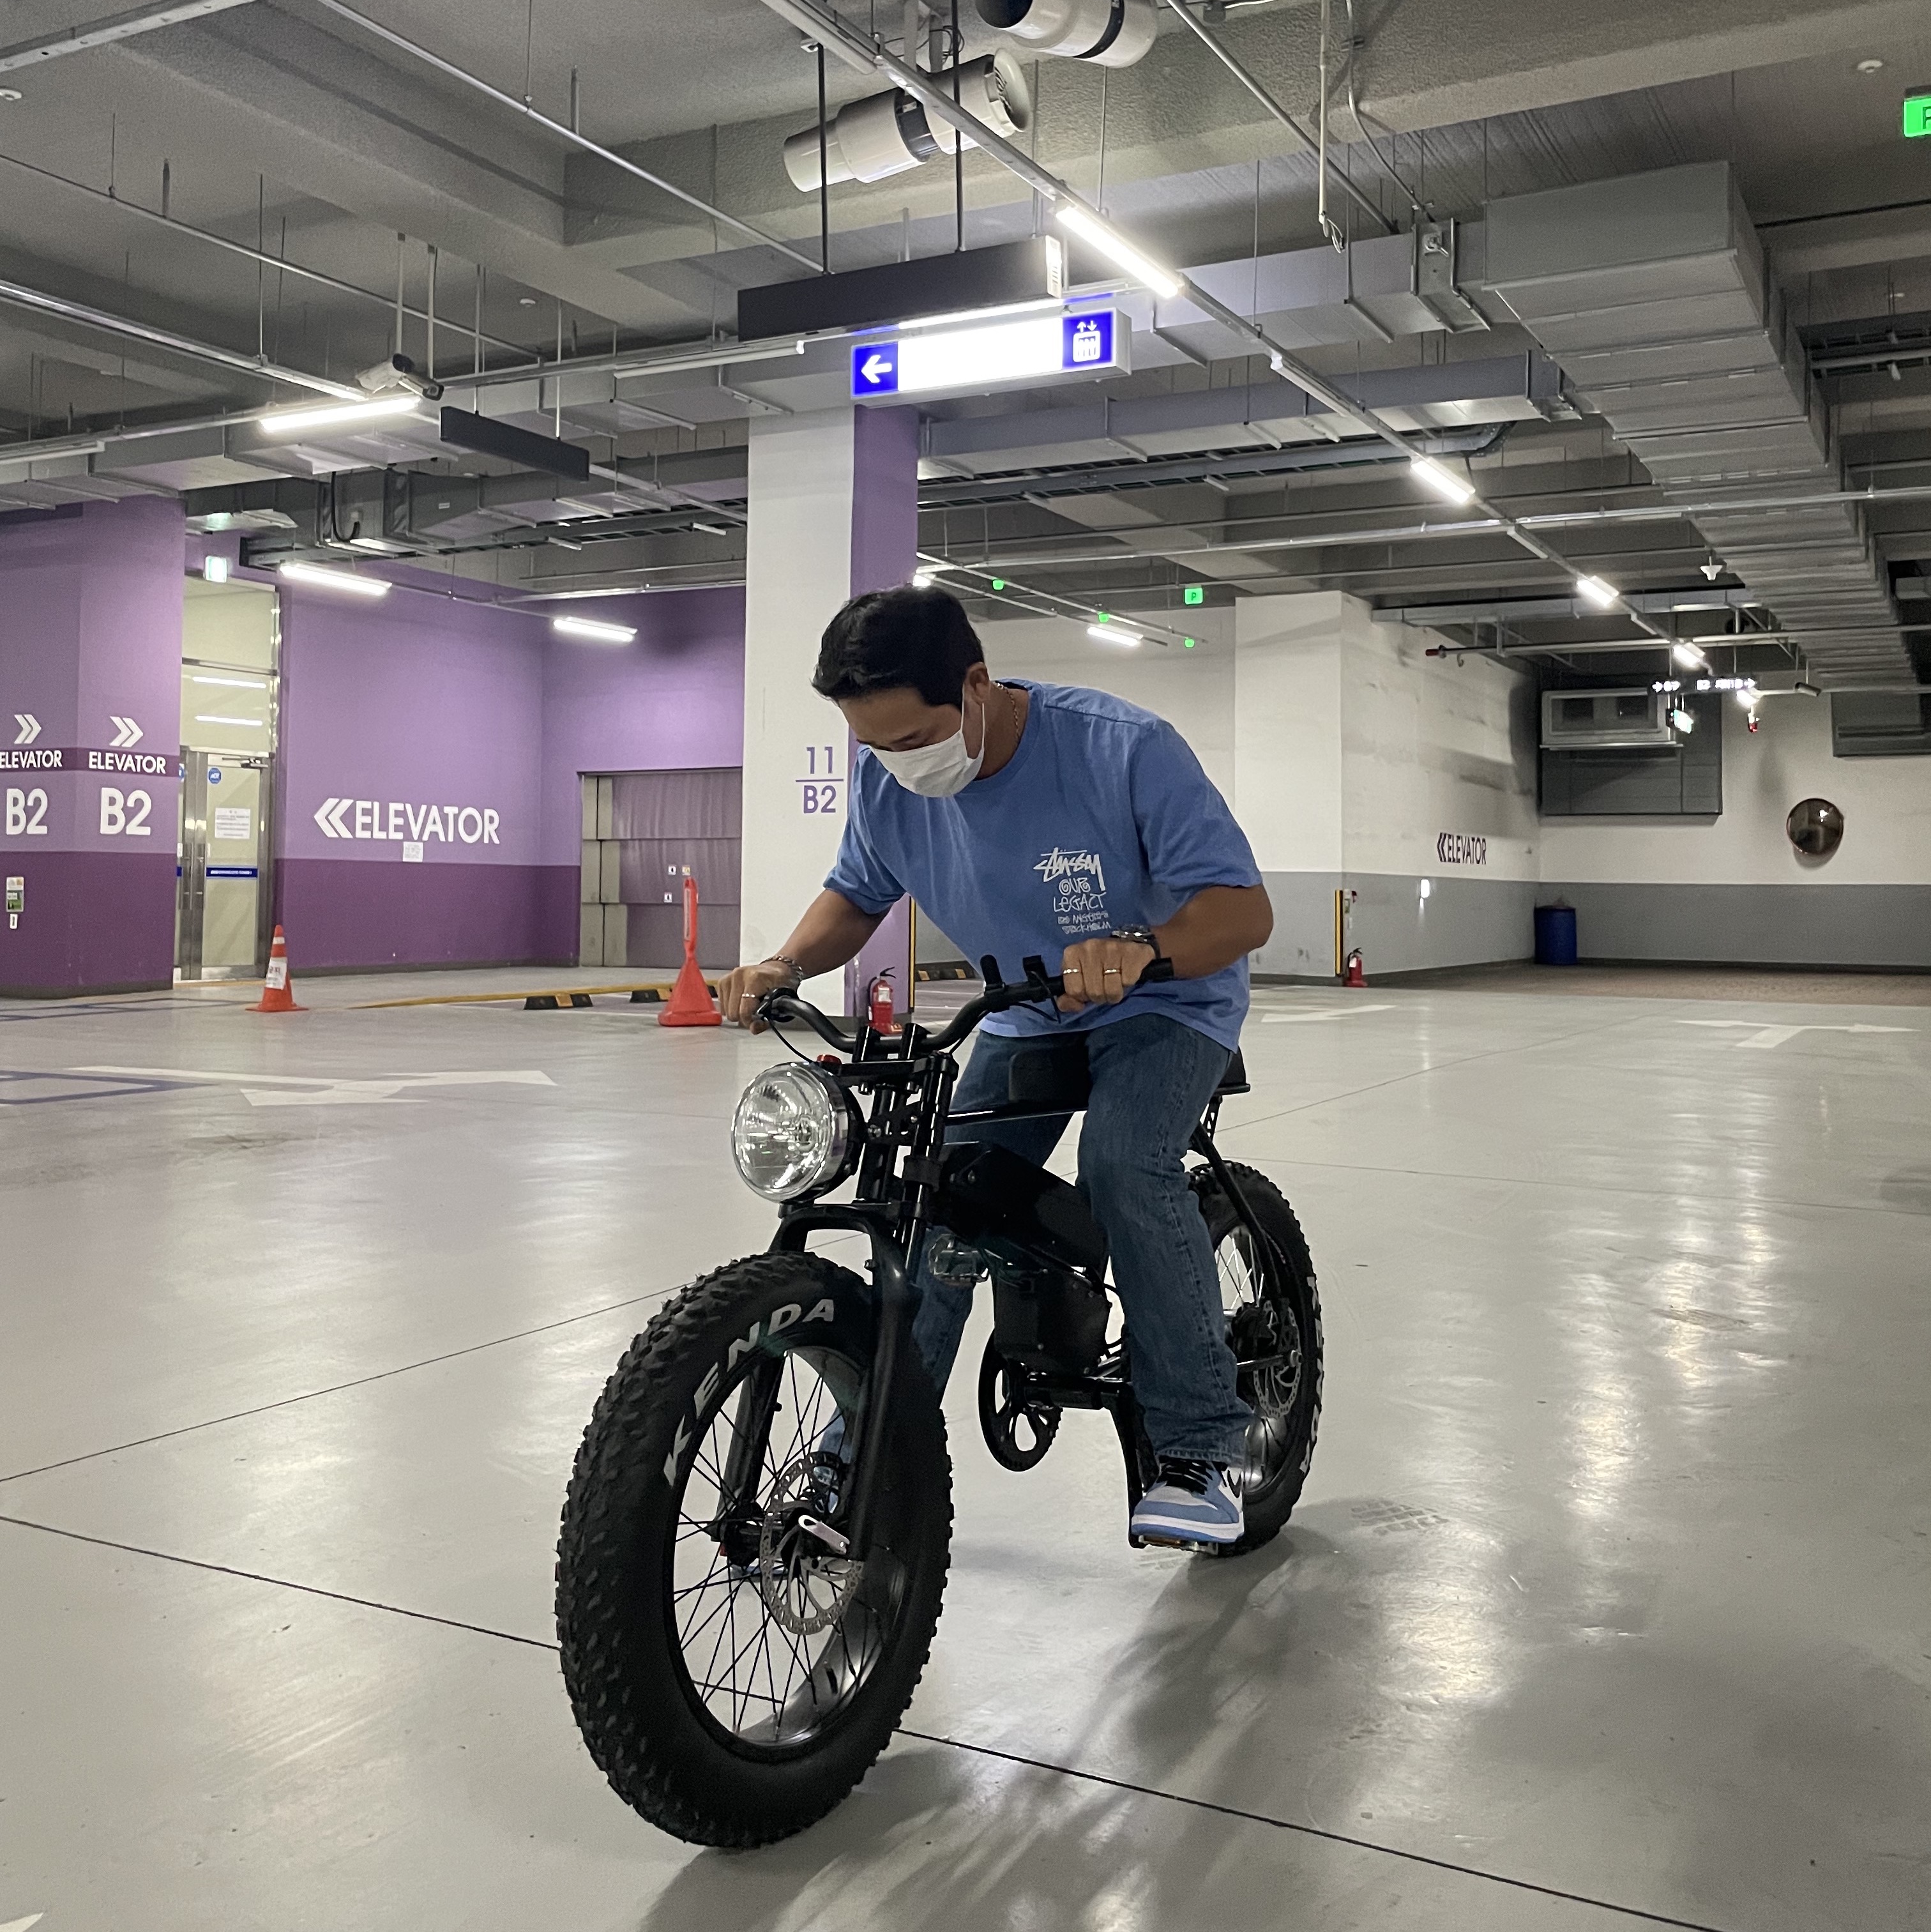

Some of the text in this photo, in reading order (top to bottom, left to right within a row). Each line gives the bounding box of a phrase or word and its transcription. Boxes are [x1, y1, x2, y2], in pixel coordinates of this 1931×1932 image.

[0, 750, 63, 769] ELEVATOR
[89, 751, 166, 774] ELEVATOR
[806, 746, 833, 775] 11
[6, 788, 49, 835] B2
[100, 787, 152, 835] B2
[803, 785, 837, 814] B2
[355, 800, 500, 844] ELEVATOR
[1447, 834, 1487, 865] ELEVATOR
[663, 1298, 835, 1488] KENDA
